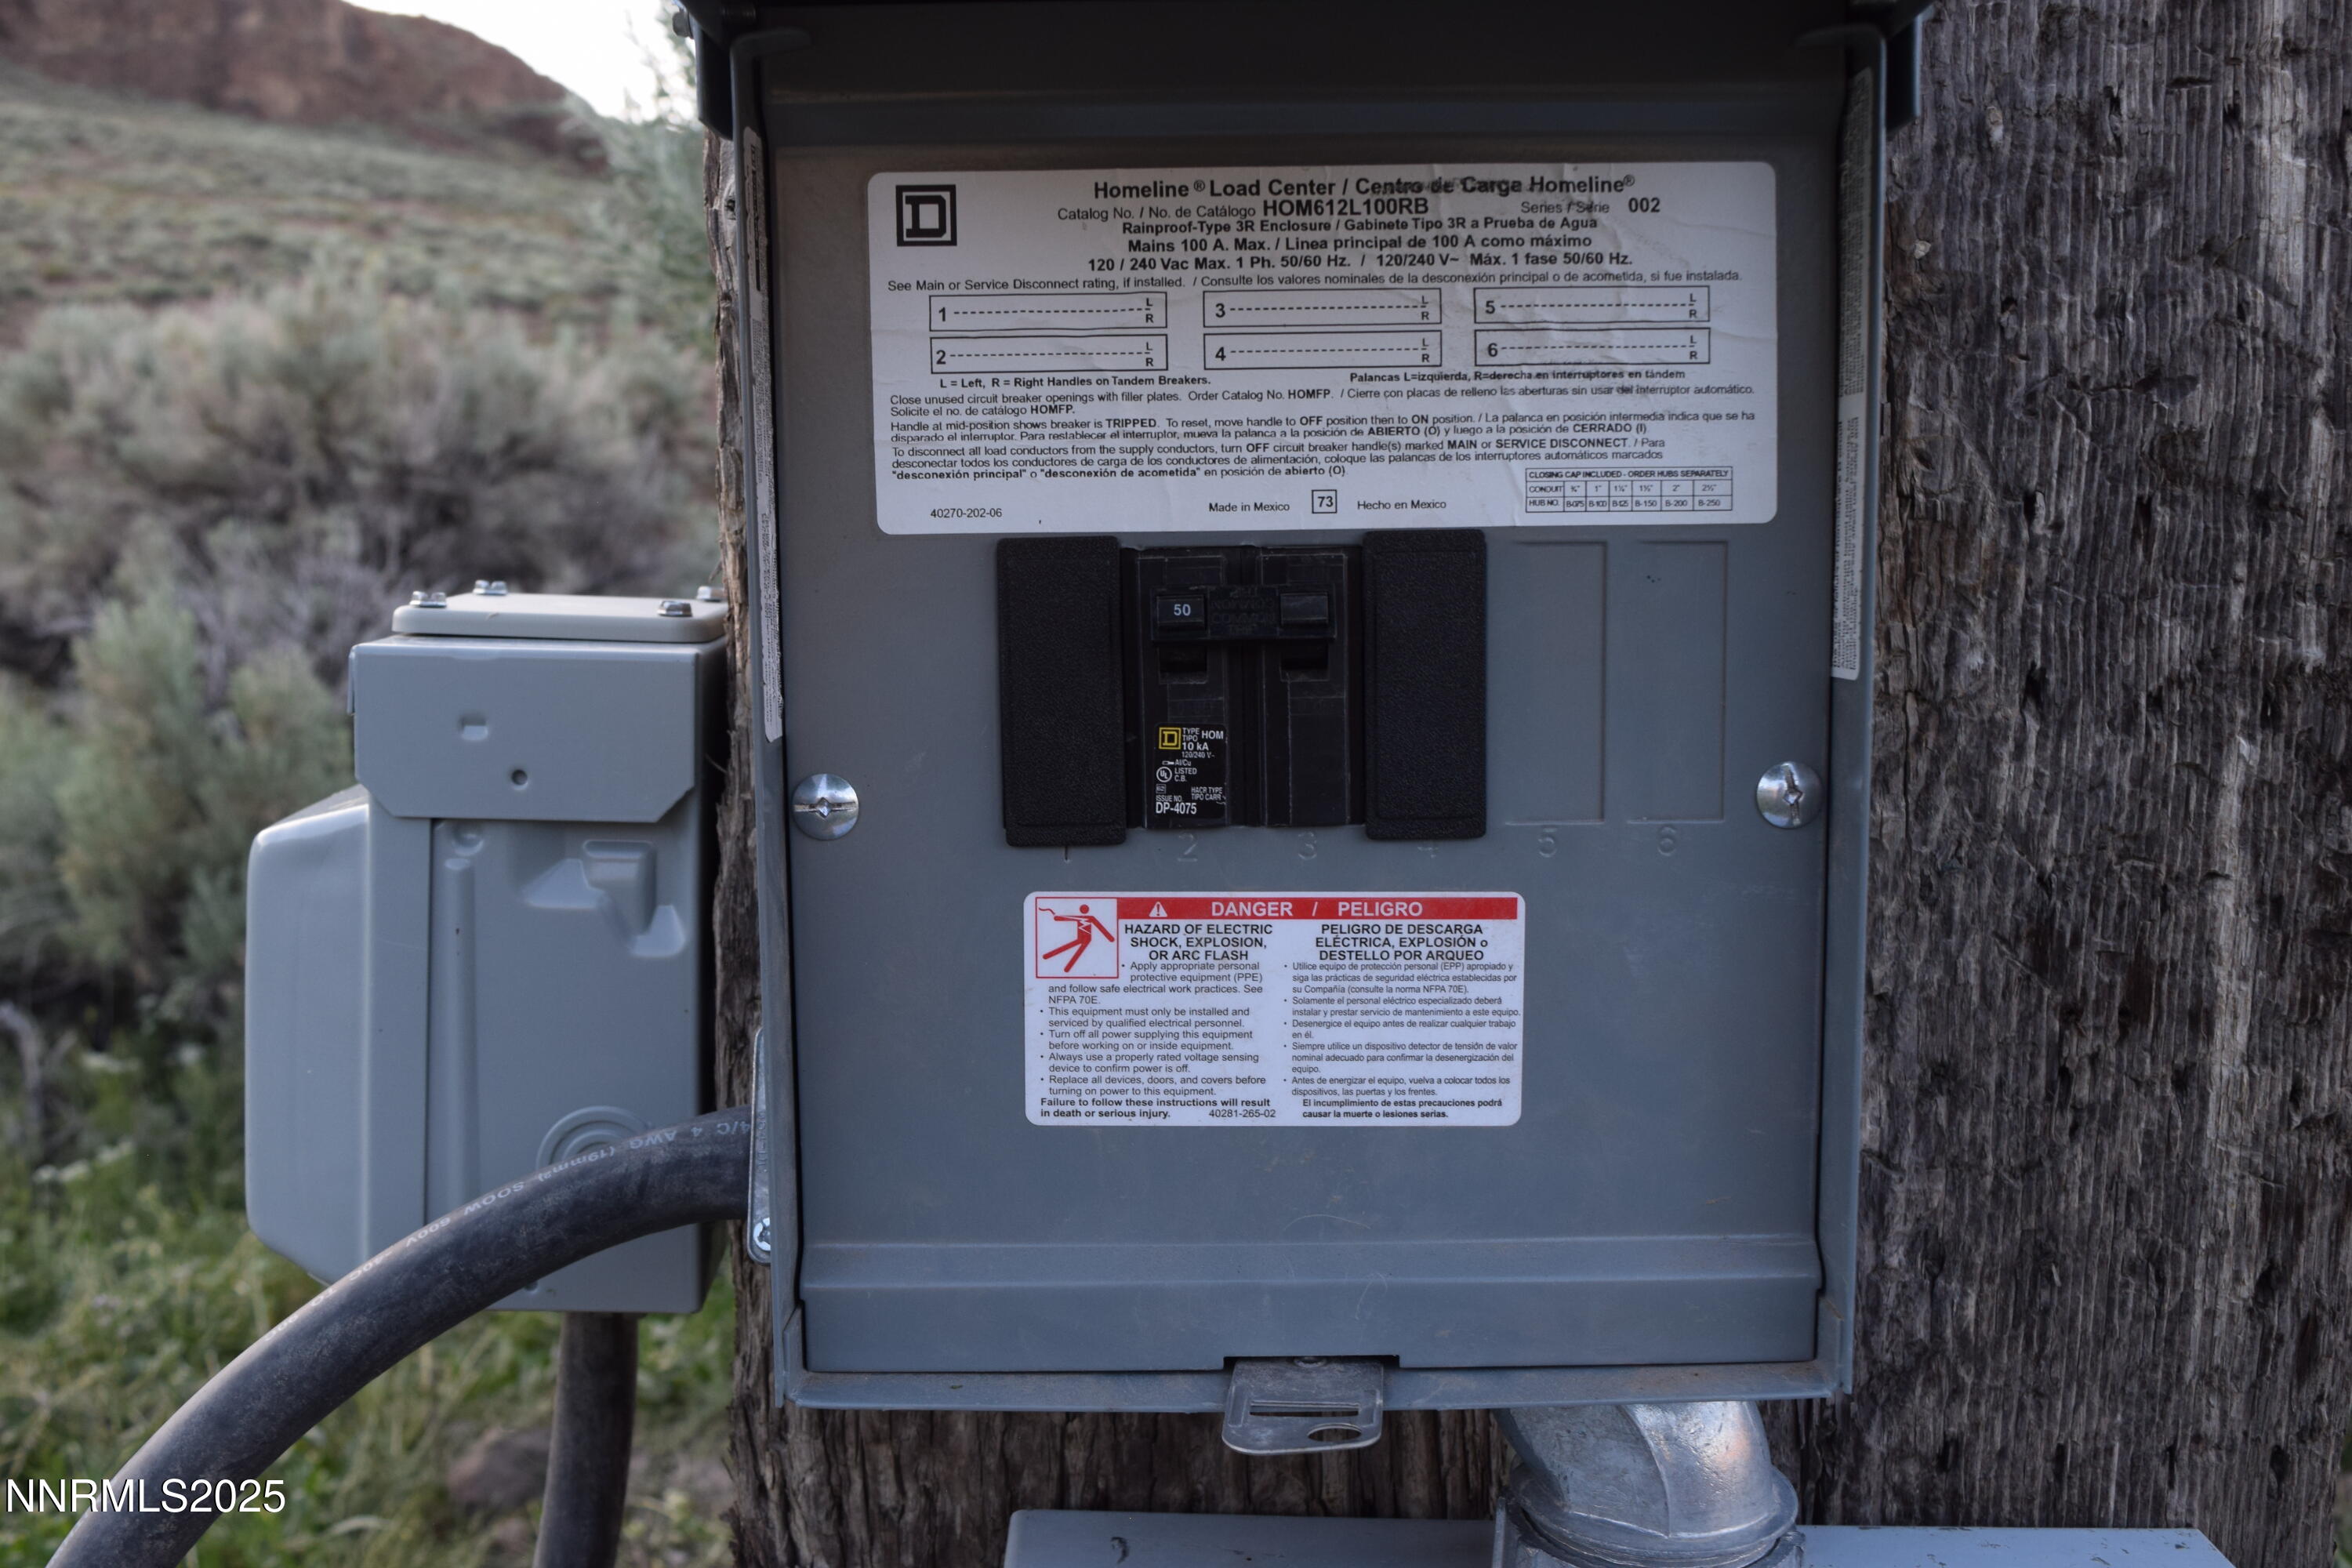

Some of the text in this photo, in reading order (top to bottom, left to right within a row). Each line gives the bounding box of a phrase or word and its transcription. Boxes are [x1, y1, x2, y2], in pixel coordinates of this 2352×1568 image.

[1210, 180, 1261, 197] Load
[1268, 179, 1336, 196] Center
[1342, 178, 1348, 195] /
[1356, 177, 1429, 195] Centro
[1431, 177, 1454, 194] de
[1460, 176, 1523, 197] Carga
[1058, 198, 1429, 223] Catalog No. / No. de Catálogo HOM612L100RB
[1520, 201, 1564, 213] Series
[1628, 198, 1661, 212] 002
[1123, 216, 1598, 236] Rainproof-Type 3R Enclosure / Gabinete Tipo 3R a Prueba de Agua
[1128, 239, 1175, 252] Mains
[1181, 238, 1207, 252] 100
[1212, 238, 1229, 252] A.
[1234, 238, 1270, 251] Max.
[1275, 237, 1280, 251] /
[1334, 236, 1402, 252] principal
[1406, 235, 1427, 249] de
[1432, 234, 1459, 248] 100
[1464, 234, 1475, 248] A
[1481, 237, 1525, 247] como
[1530, 234, 1592, 247] máximo
[1088, 258, 1115, 271] 120
[1120, 258, 1124, 270] /
[1130, 257, 1156, 270] 240
[1160, 258, 1189, 270] Vac
[1194, 257, 1230, 270] Max.
[1236, 256, 1243, 268] 1
[1250, 256, 1275, 268] Ph.
[1280, 255, 1322, 267] 50/60
[1327, 254, 1351, 267] Hz.
[1360, 254, 1366, 267] /
[1376, 253, 1435, 267] 120/240
[1470, 252, 1506, 266] Máx.
[1512, 252, 1518, 265] 1
[1524, 252, 1558, 265] fase
[1563, 252, 1604, 265] 50/60
[1609, 252, 1632, 265] Hz.
[1215, 303, 1226, 318] 3
[1485, 300, 1495, 314] 5
[938, 307, 946, 322] 1
[1215, 347, 1226, 361] 4
[1487, 343, 1498, 357] 6
[936, 350, 946, 365] 2
[940, 379, 947, 388] L
[961, 378, 985, 389] Left,
[991, 377, 1000, 387] R
[1014, 377, 1044, 389] Right
[1047, 376, 1093, 387] Handles
[1112, 376, 1155, 386] Tandem
[1158, 375, 1211, 385] Breakers.
[1317, 495, 1334, 508] 73
[930, 507, 1003, 518] 40270-202-06
[1174, 604, 1191, 616] 50
[1201, 731, 1223, 739] HOM
[1156, 802, 1197, 814] DP-4075
[1177, 833, 1198, 862] 2
[1298, 831, 1317, 860] 3
[1538, 828, 1557, 858] 5
[1657, 826, 1676, 856] 6
[1211, 901, 1424, 916] DANGER / PELIGRO
[1124, 924, 1272, 935] HAZARD OF ELECTRIC
[1321, 924, 1483, 935] PELIGRO DE DESCARGA
[1131, 937, 1267, 949] SHOCK, EXPLOSION,
[1316, 935, 1488, 949] ELÉCTRICA, EXPLOSIÓN o
[1149, 949, 1248, 960] OR ARC FLASH
[1319, 950, 1484, 960] DESTELLO POR ARQUEO
[1130, 961, 1260, 972] Apply appropriate personal
[1131, 972, 1263, 983] protective equipment (PPE)
[1040, 1098, 1076, 1106] Failure
[1091, 1098, 1123, 1106] follow
[1241, 1098, 1270, 1107] result
[1040, 1109, 1050, 1117] in
[1053, 1109, 1082, 1117] death
[1098, 1109, 1136, 1118] serious
[1139, 1109, 1171, 1120] injury.
[1208, 1109, 1276, 1118] 40281-265-02
